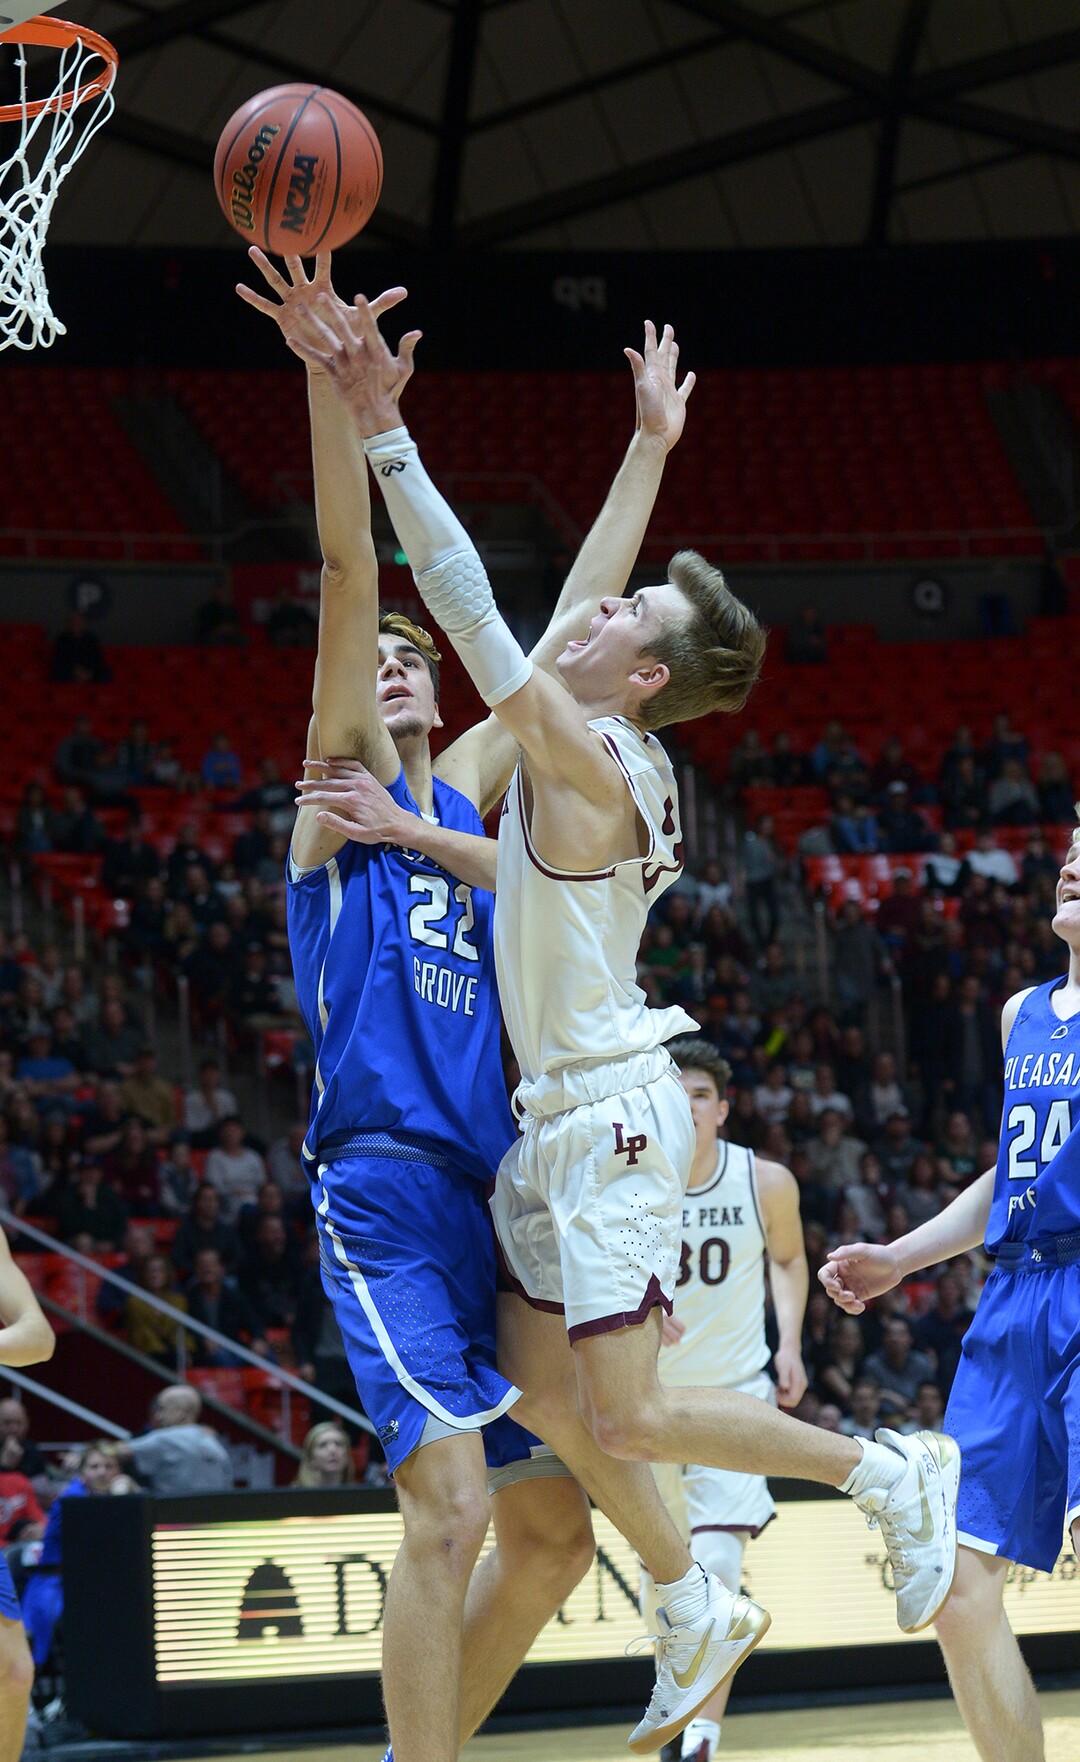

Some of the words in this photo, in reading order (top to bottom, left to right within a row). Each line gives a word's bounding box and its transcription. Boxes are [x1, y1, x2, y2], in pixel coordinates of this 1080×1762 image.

[229, 123, 281, 233] Wilson
[279, 151, 319, 234] NCAA
[409, 873, 479, 961] 22
[413, 956, 478, 1016] GROVE
[612, 1122, 647, 1166] LP
[1008, 1100, 1072, 1179] 24
[699, 1206, 744, 1226] PEAK
